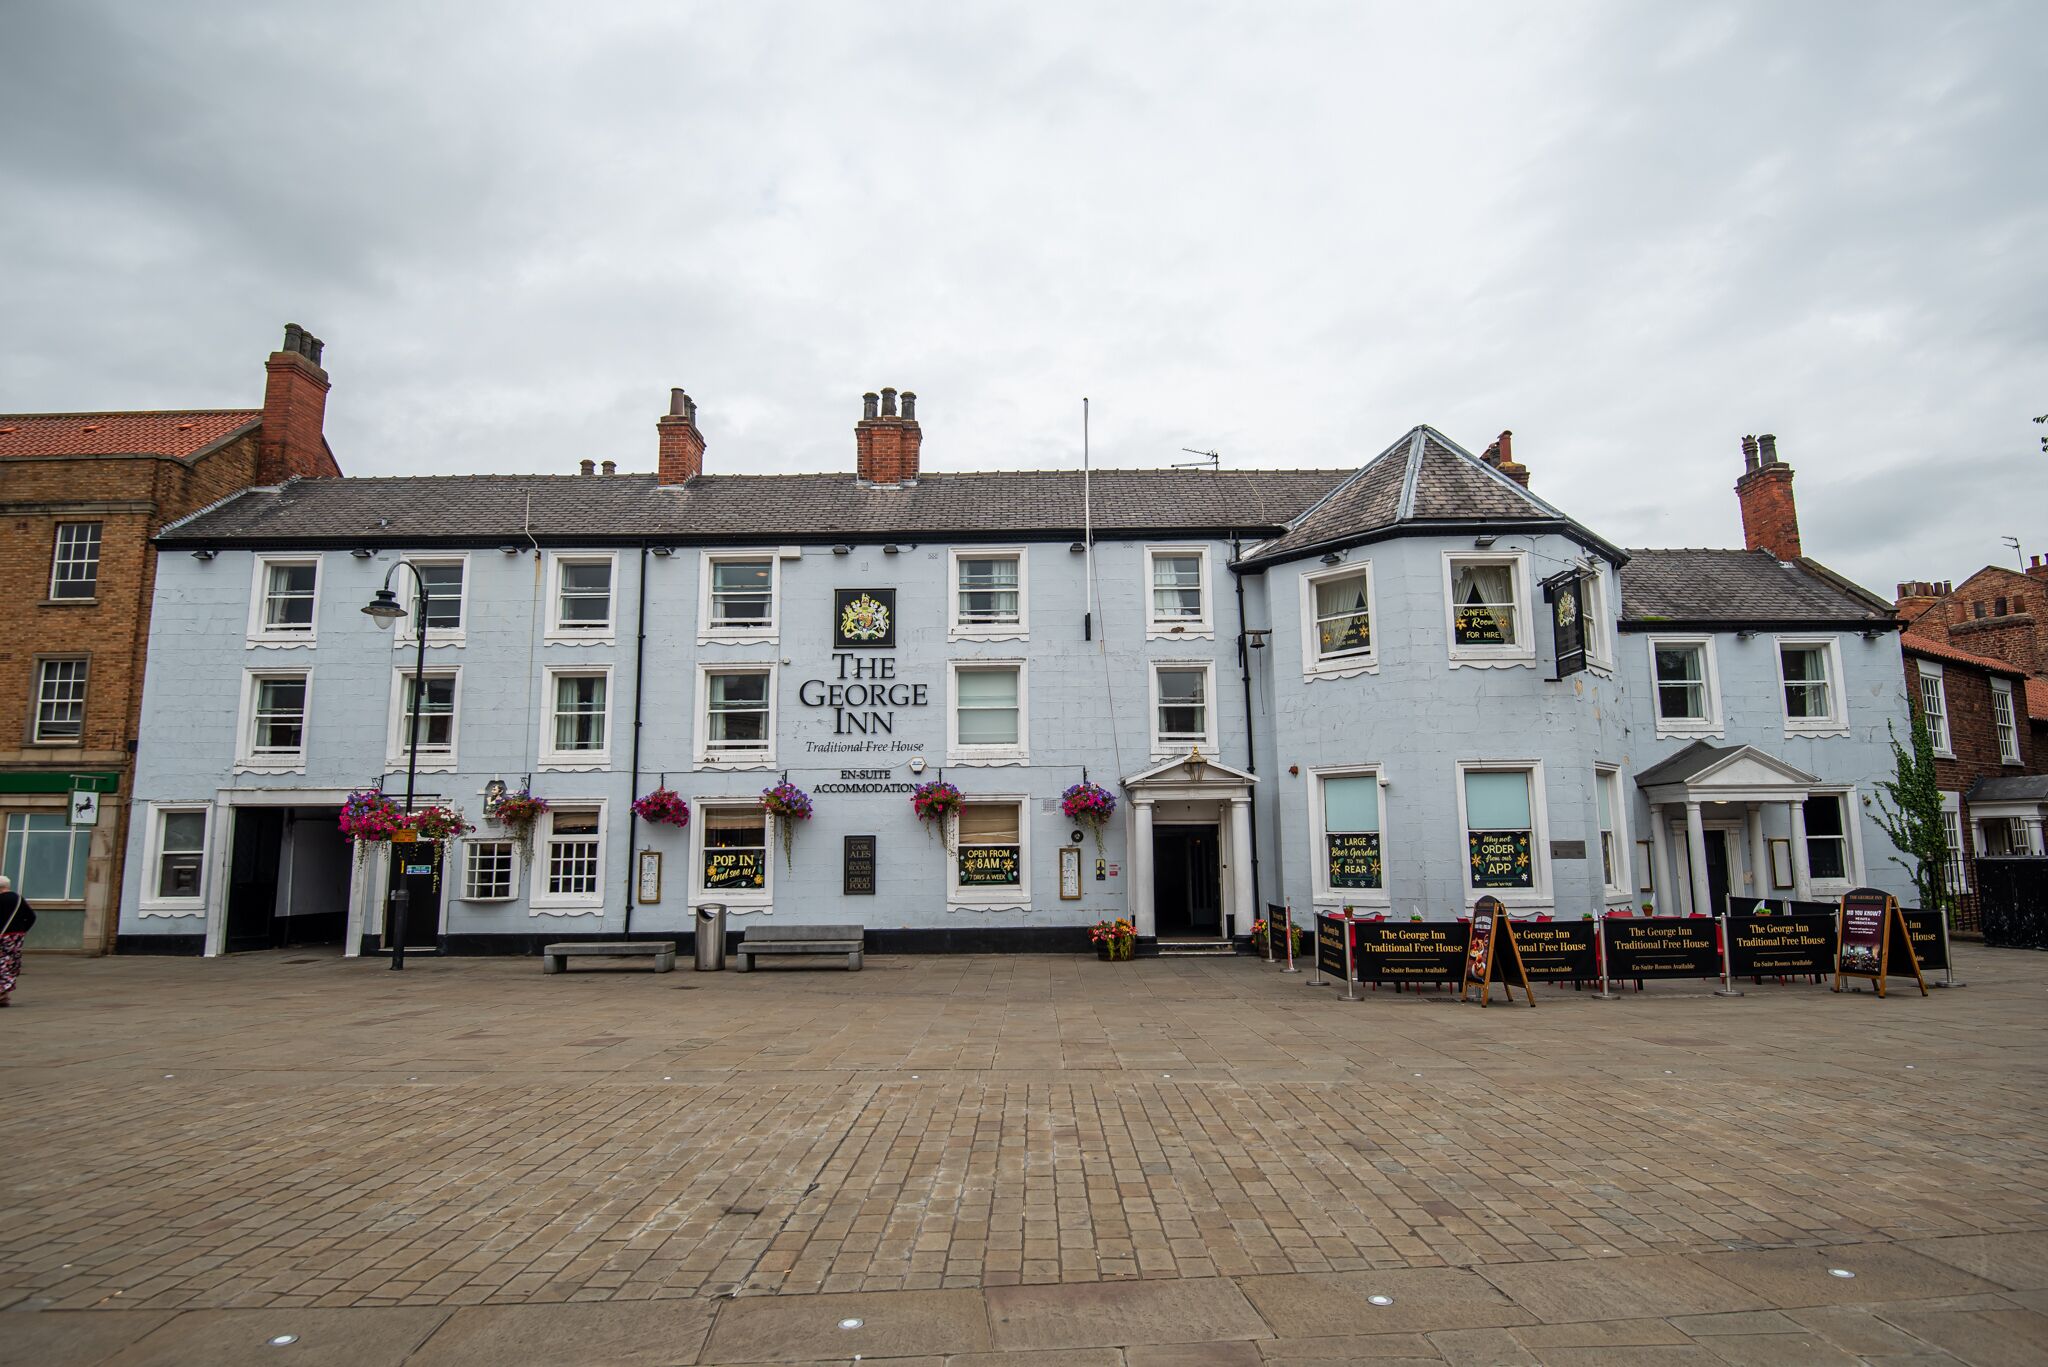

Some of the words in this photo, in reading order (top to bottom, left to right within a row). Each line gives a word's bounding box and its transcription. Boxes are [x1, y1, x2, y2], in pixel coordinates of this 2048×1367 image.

[832, 653, 896, 679] THE
[800, 680, 928, 707] GEORGE
[833, 707, 894, 734] INN
[806, 741, 863, 752] Traditional
[866, 741, 888, 752] Free
[891, 740, 924, 751] House
[841, 770, 891, 780] EN-SUITE
[813, 783, 918, 793] ACCOMMODATION
[1344, 838, 1366, 846] LARGE
[1483, 836, 1497, 844] Why
[1499, 835, 1511, 843] not
[967, 850, 988, 858] OPEN
[1331, 847, 1349, 857] Beer
[1350, 847, 1378, 858] Garden
[1482, 845, 1514, 854] ORDER
[713, 855, 737, 866] POP
[739, 854, 755, 866] IN
[977, 858, 1000, 868] 8AM
[711, 868, 730, 881] and
[730, 869, 741, 877] see
[742, 866, 756, 877] us!
[1488, 863, 1511, 874] APP
[1750, 924, 1765, 933] The
[1767, 924, 1794, 934] George
[1796, 923, 1809, 932] Inn
[1909, 920, 1921, 928] Inn
[1380, 930, 1397, 939] The
[1399, 930, 1429, 941] George
[1431, 930, 1446, 939] Inn
[1523, 930, 1554, 940] George
[1556, 930, 1570, 939] Inn
[1629, 928, 1645, 936] The
[1647, 927, 1676, 937] George
[1678, 926, 1692, 935] Inn
[1912, 932, 1936, 941] House
[1615, 940, 1661, 950] Traditional
[1663, 940, 1681, 948] Free
[1683, 939, 1709, 948] House
[1736, 937, 1780, 947] Traditional
[1782, 936, 1799, 945] Free
[1801, 935, 1825, 945] House
[1364, 943, 1413, 952] Traditional
[1415, 943, 1434, 952] Free
[1436, 943, 1463, 952] House
[1540, 943, 1558, 952] Free
[1561, 942, 1586, 951] House
